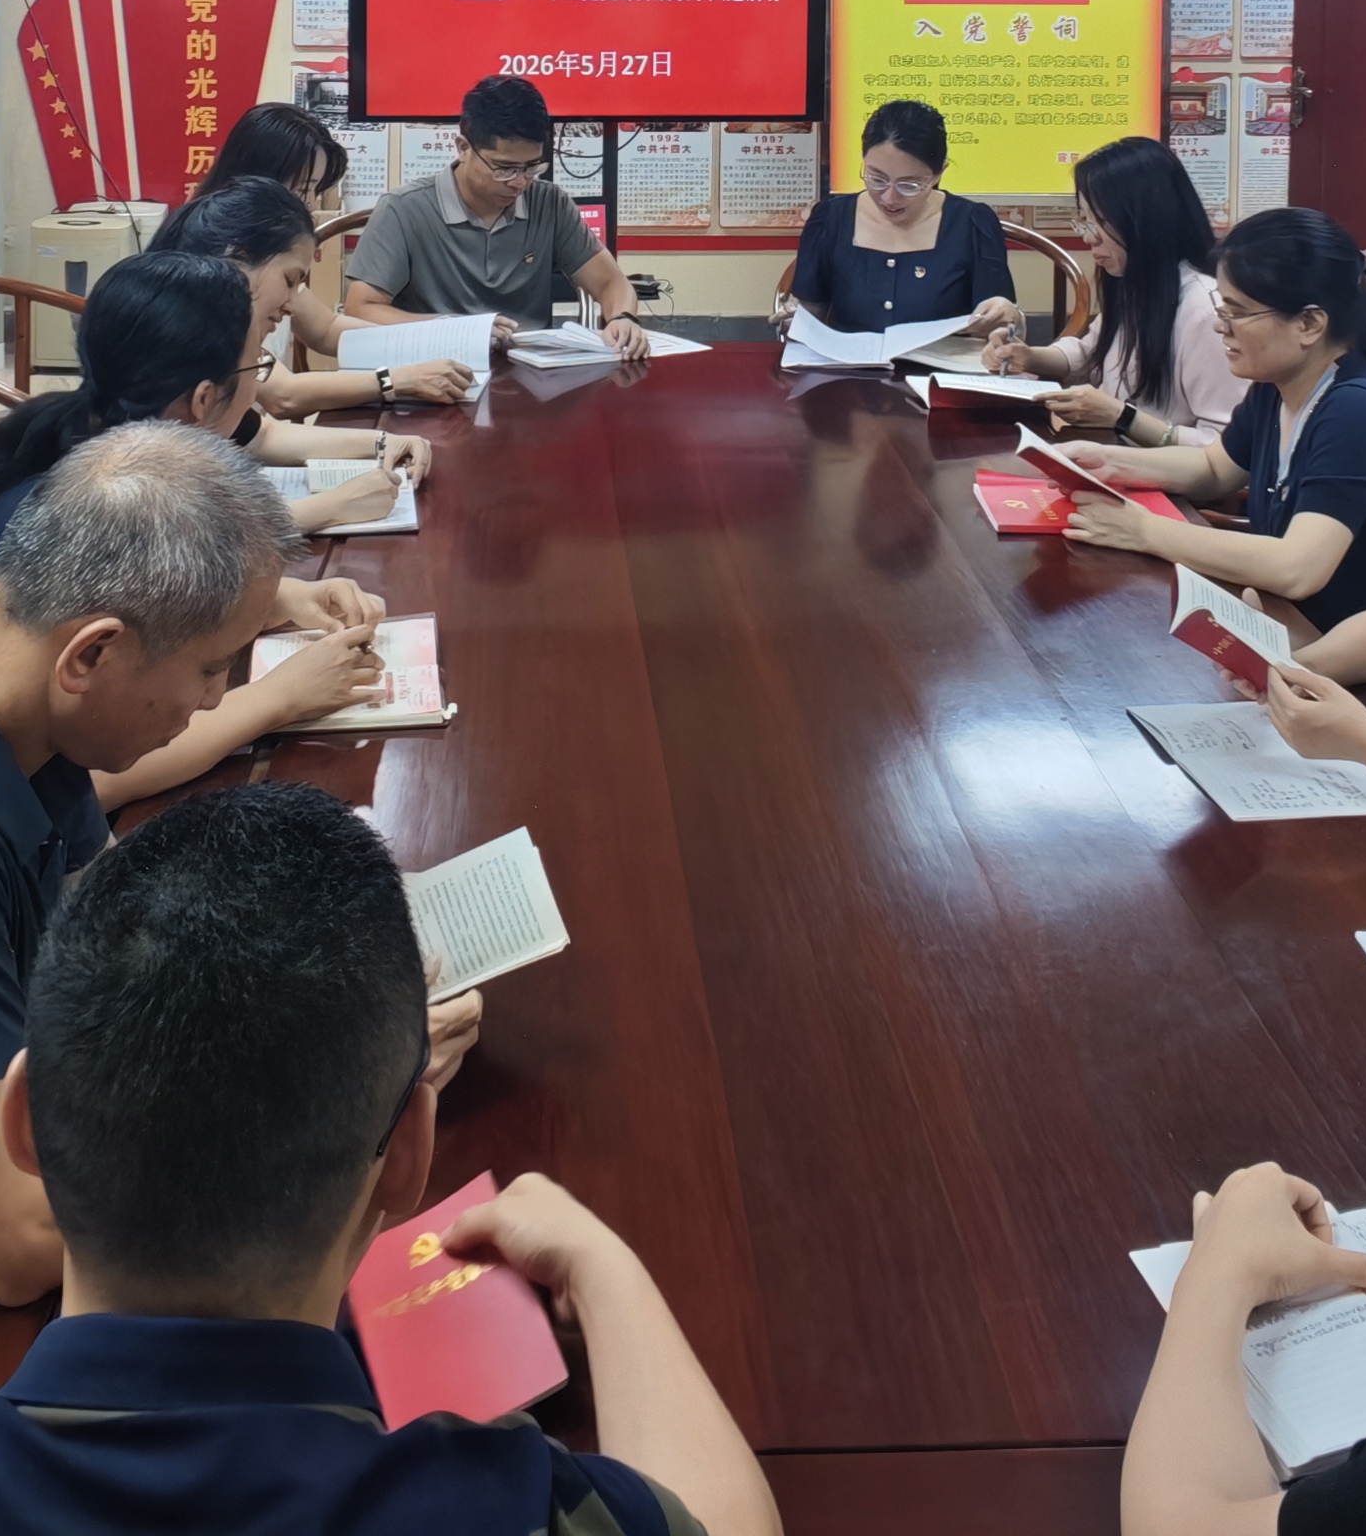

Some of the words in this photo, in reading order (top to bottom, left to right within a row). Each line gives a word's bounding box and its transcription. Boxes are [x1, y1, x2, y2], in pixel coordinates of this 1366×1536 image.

[915, 14, 1078, 43] 入党誓词
[498, 50, 673, 78] 2026年5月27日
[650, 134, 680, 142] 1992
[754, 135, 784, 143] 1997
[637, 144, 692, 154] 中共十四大
[741, 145, 796, 155] 中共十五大
